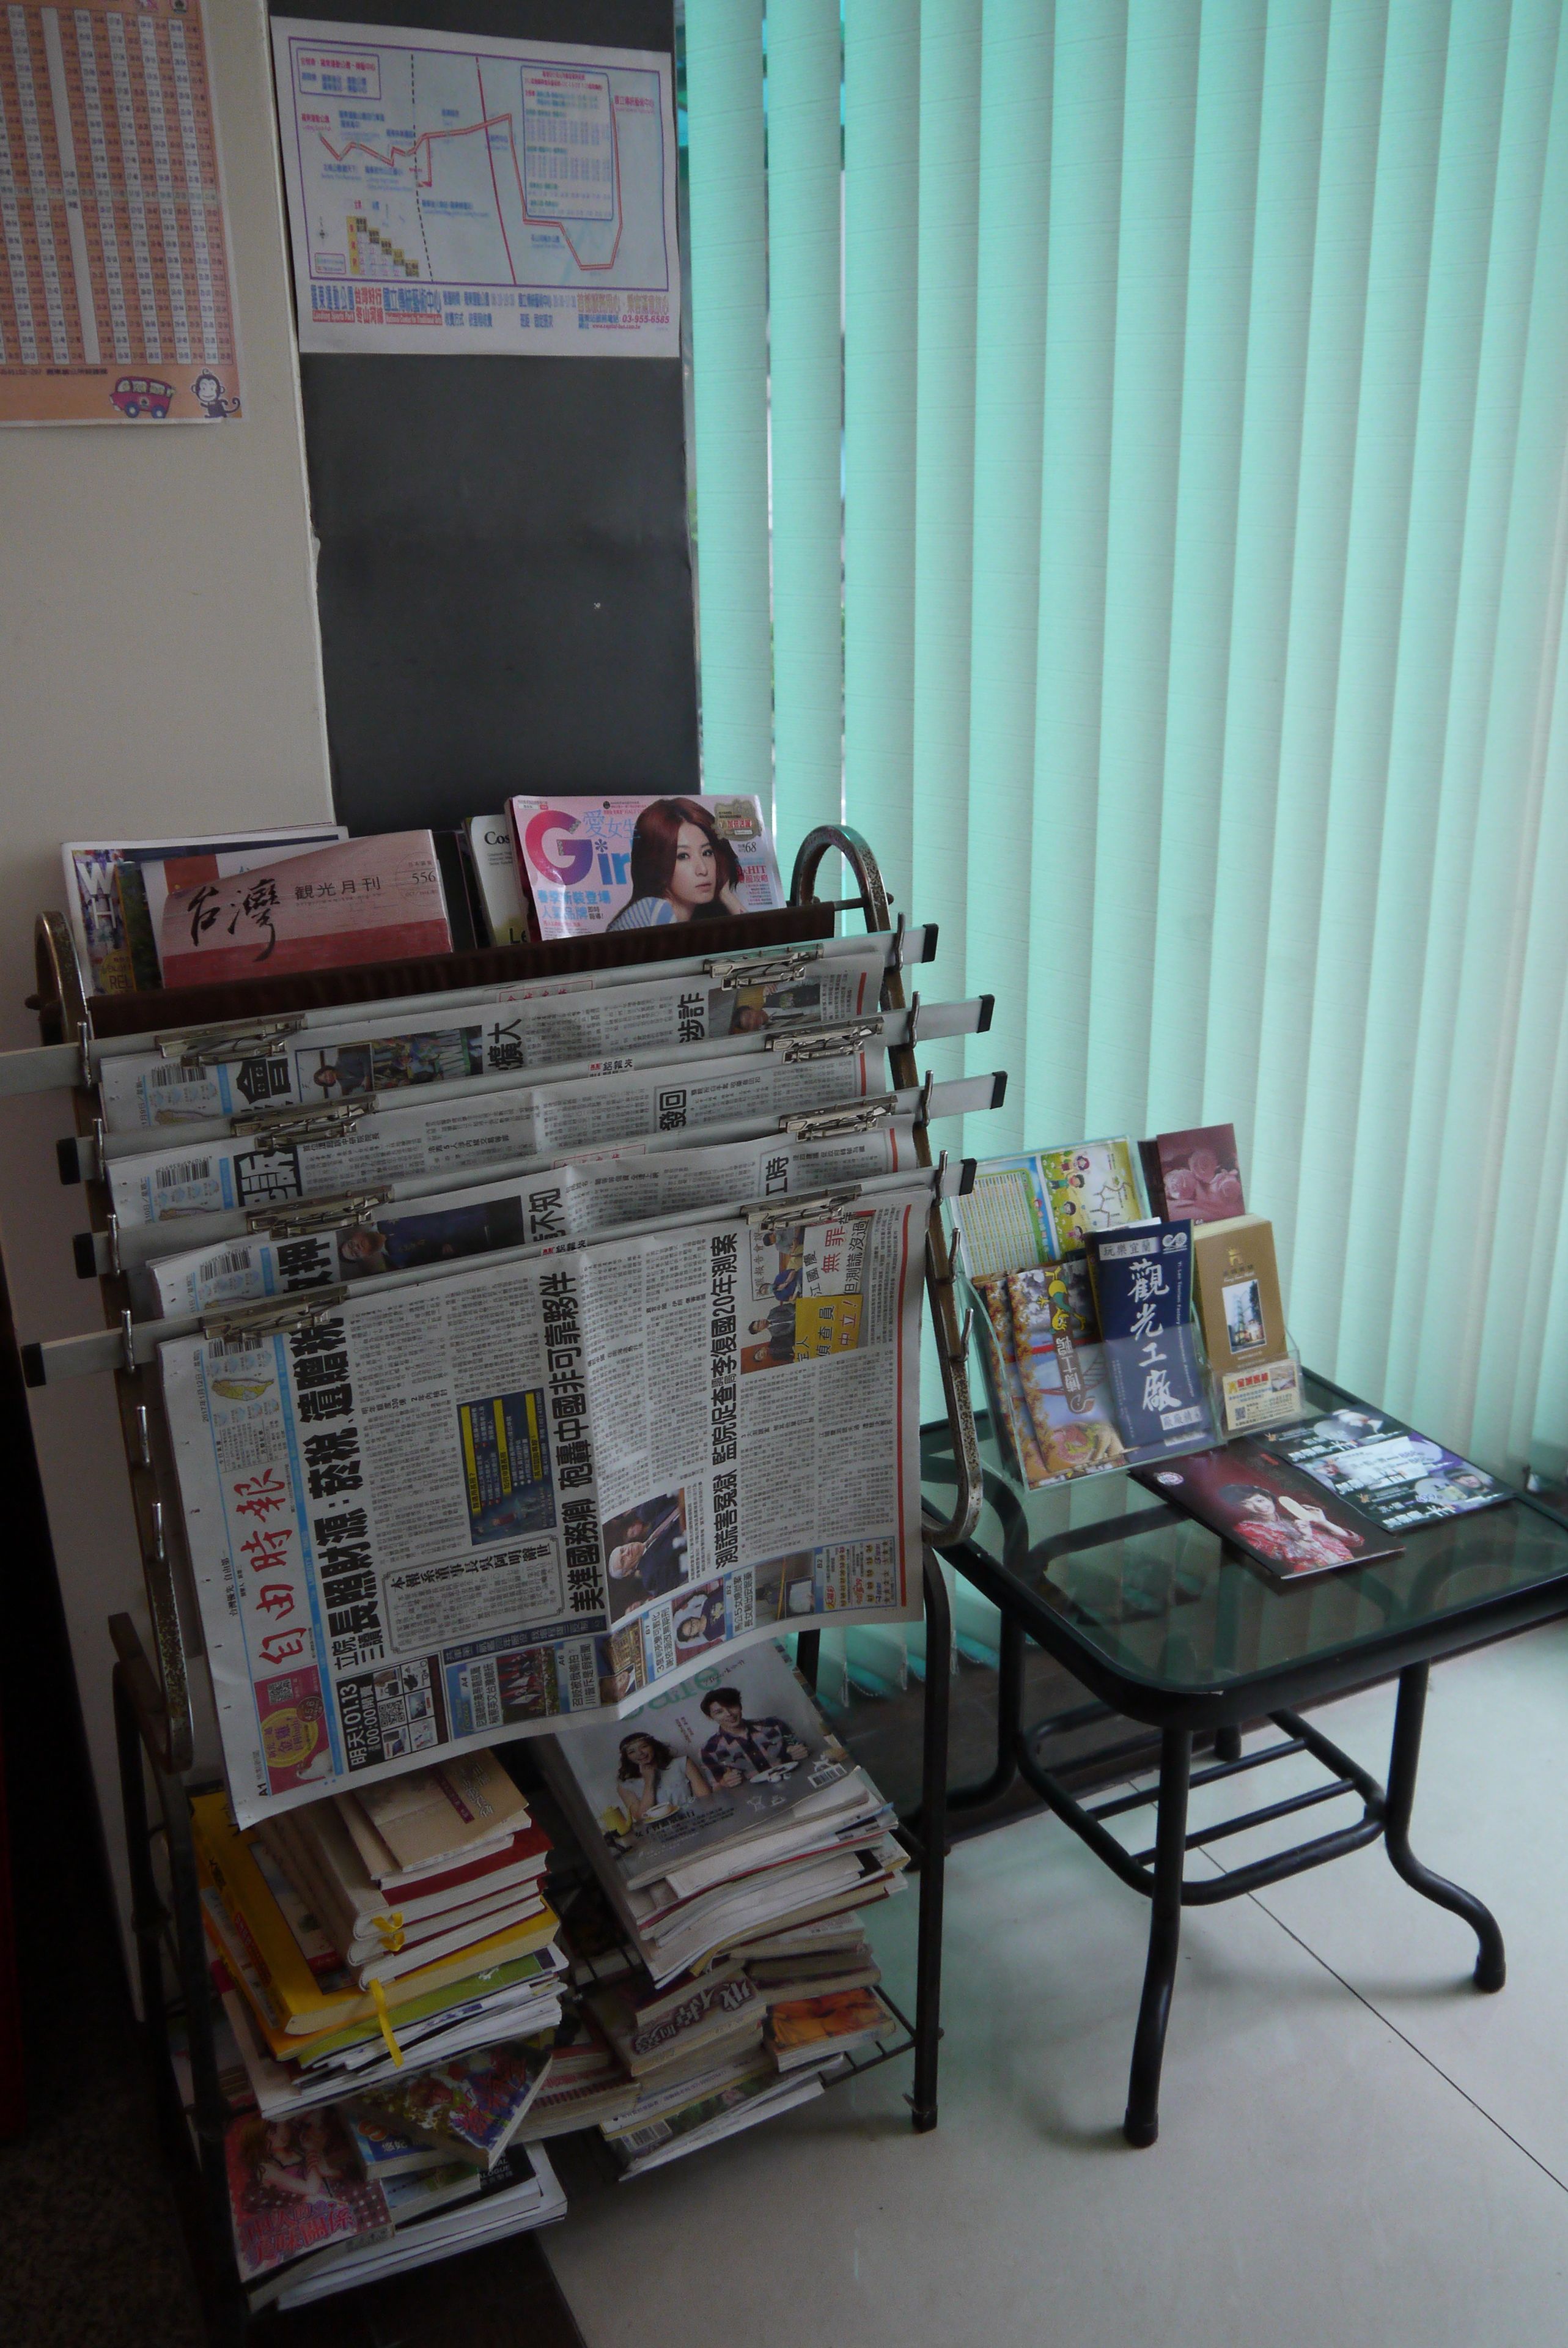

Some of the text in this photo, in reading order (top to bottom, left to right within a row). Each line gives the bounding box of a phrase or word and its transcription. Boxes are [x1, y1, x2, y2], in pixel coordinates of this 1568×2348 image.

[622, 314, 670, 324] 03-955-6585
[525, 810, 636, 885] Gir
[411, 871, 436, 885] 556
[820, 1225, 847, 1274] 無罪
[815, 1305, 836, 1357] 偵查員
[1127, 1258, 1183, 1412] 觀光工廠
[233, 1468, 311, 1665] 自由時報
[331, 1637, 359, 1671] 立院
[257, 1783, 268, 1797] A1
